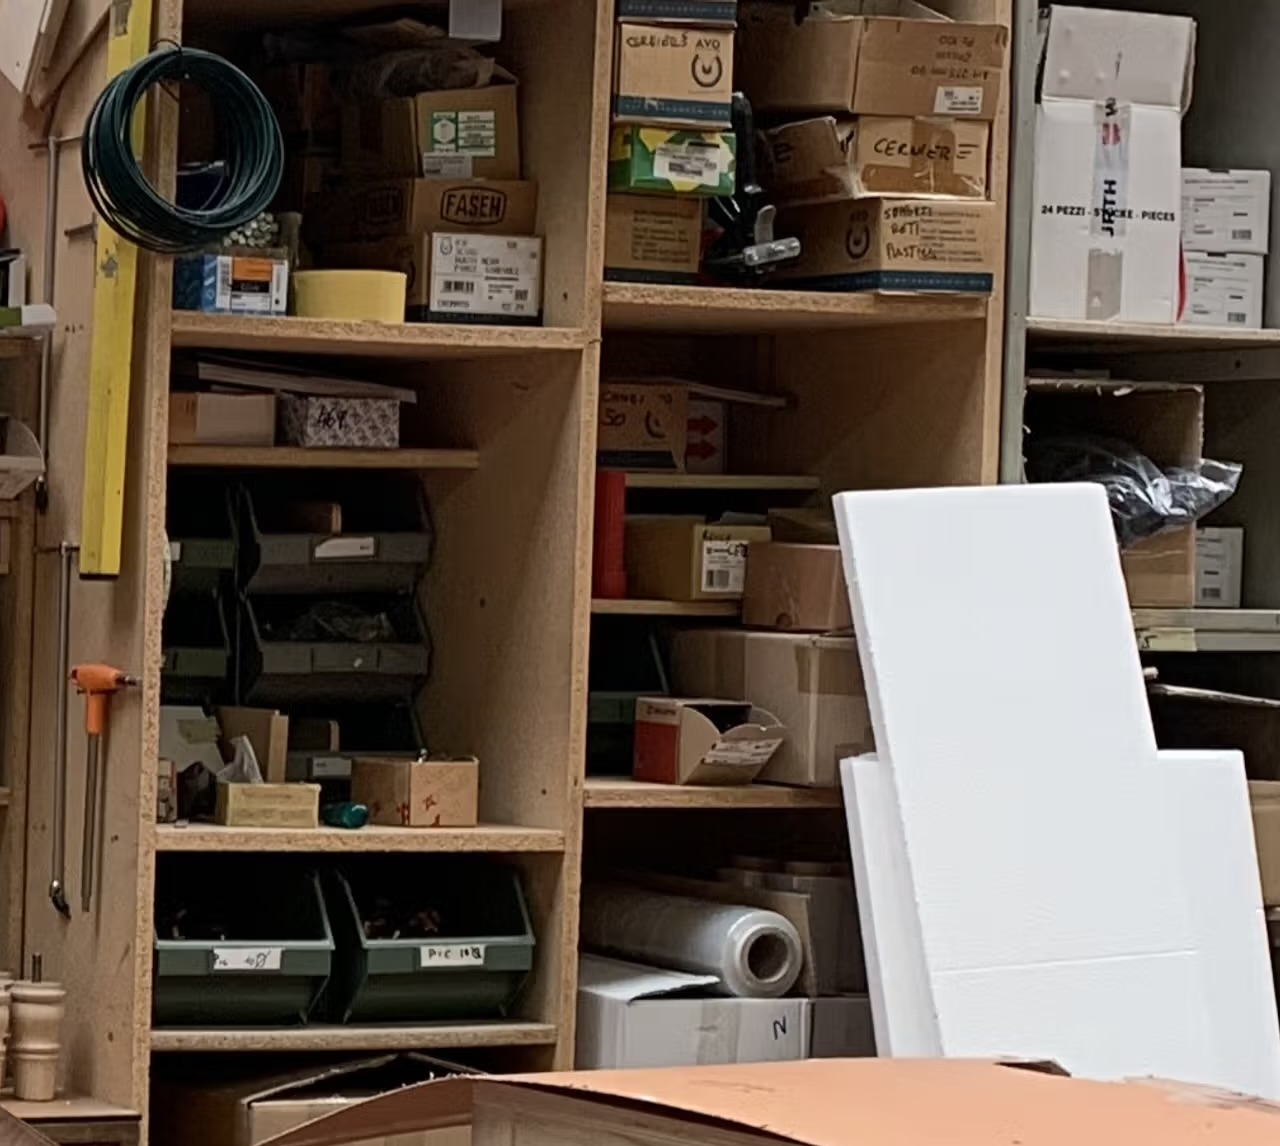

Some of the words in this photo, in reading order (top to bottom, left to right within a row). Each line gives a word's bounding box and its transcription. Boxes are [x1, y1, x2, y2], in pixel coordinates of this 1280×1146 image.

[1041, 204, 1053, 215] 24
[1056, 205, 1086, 217] PEZZI
[1141, 211, 1176, 222] PIECES
